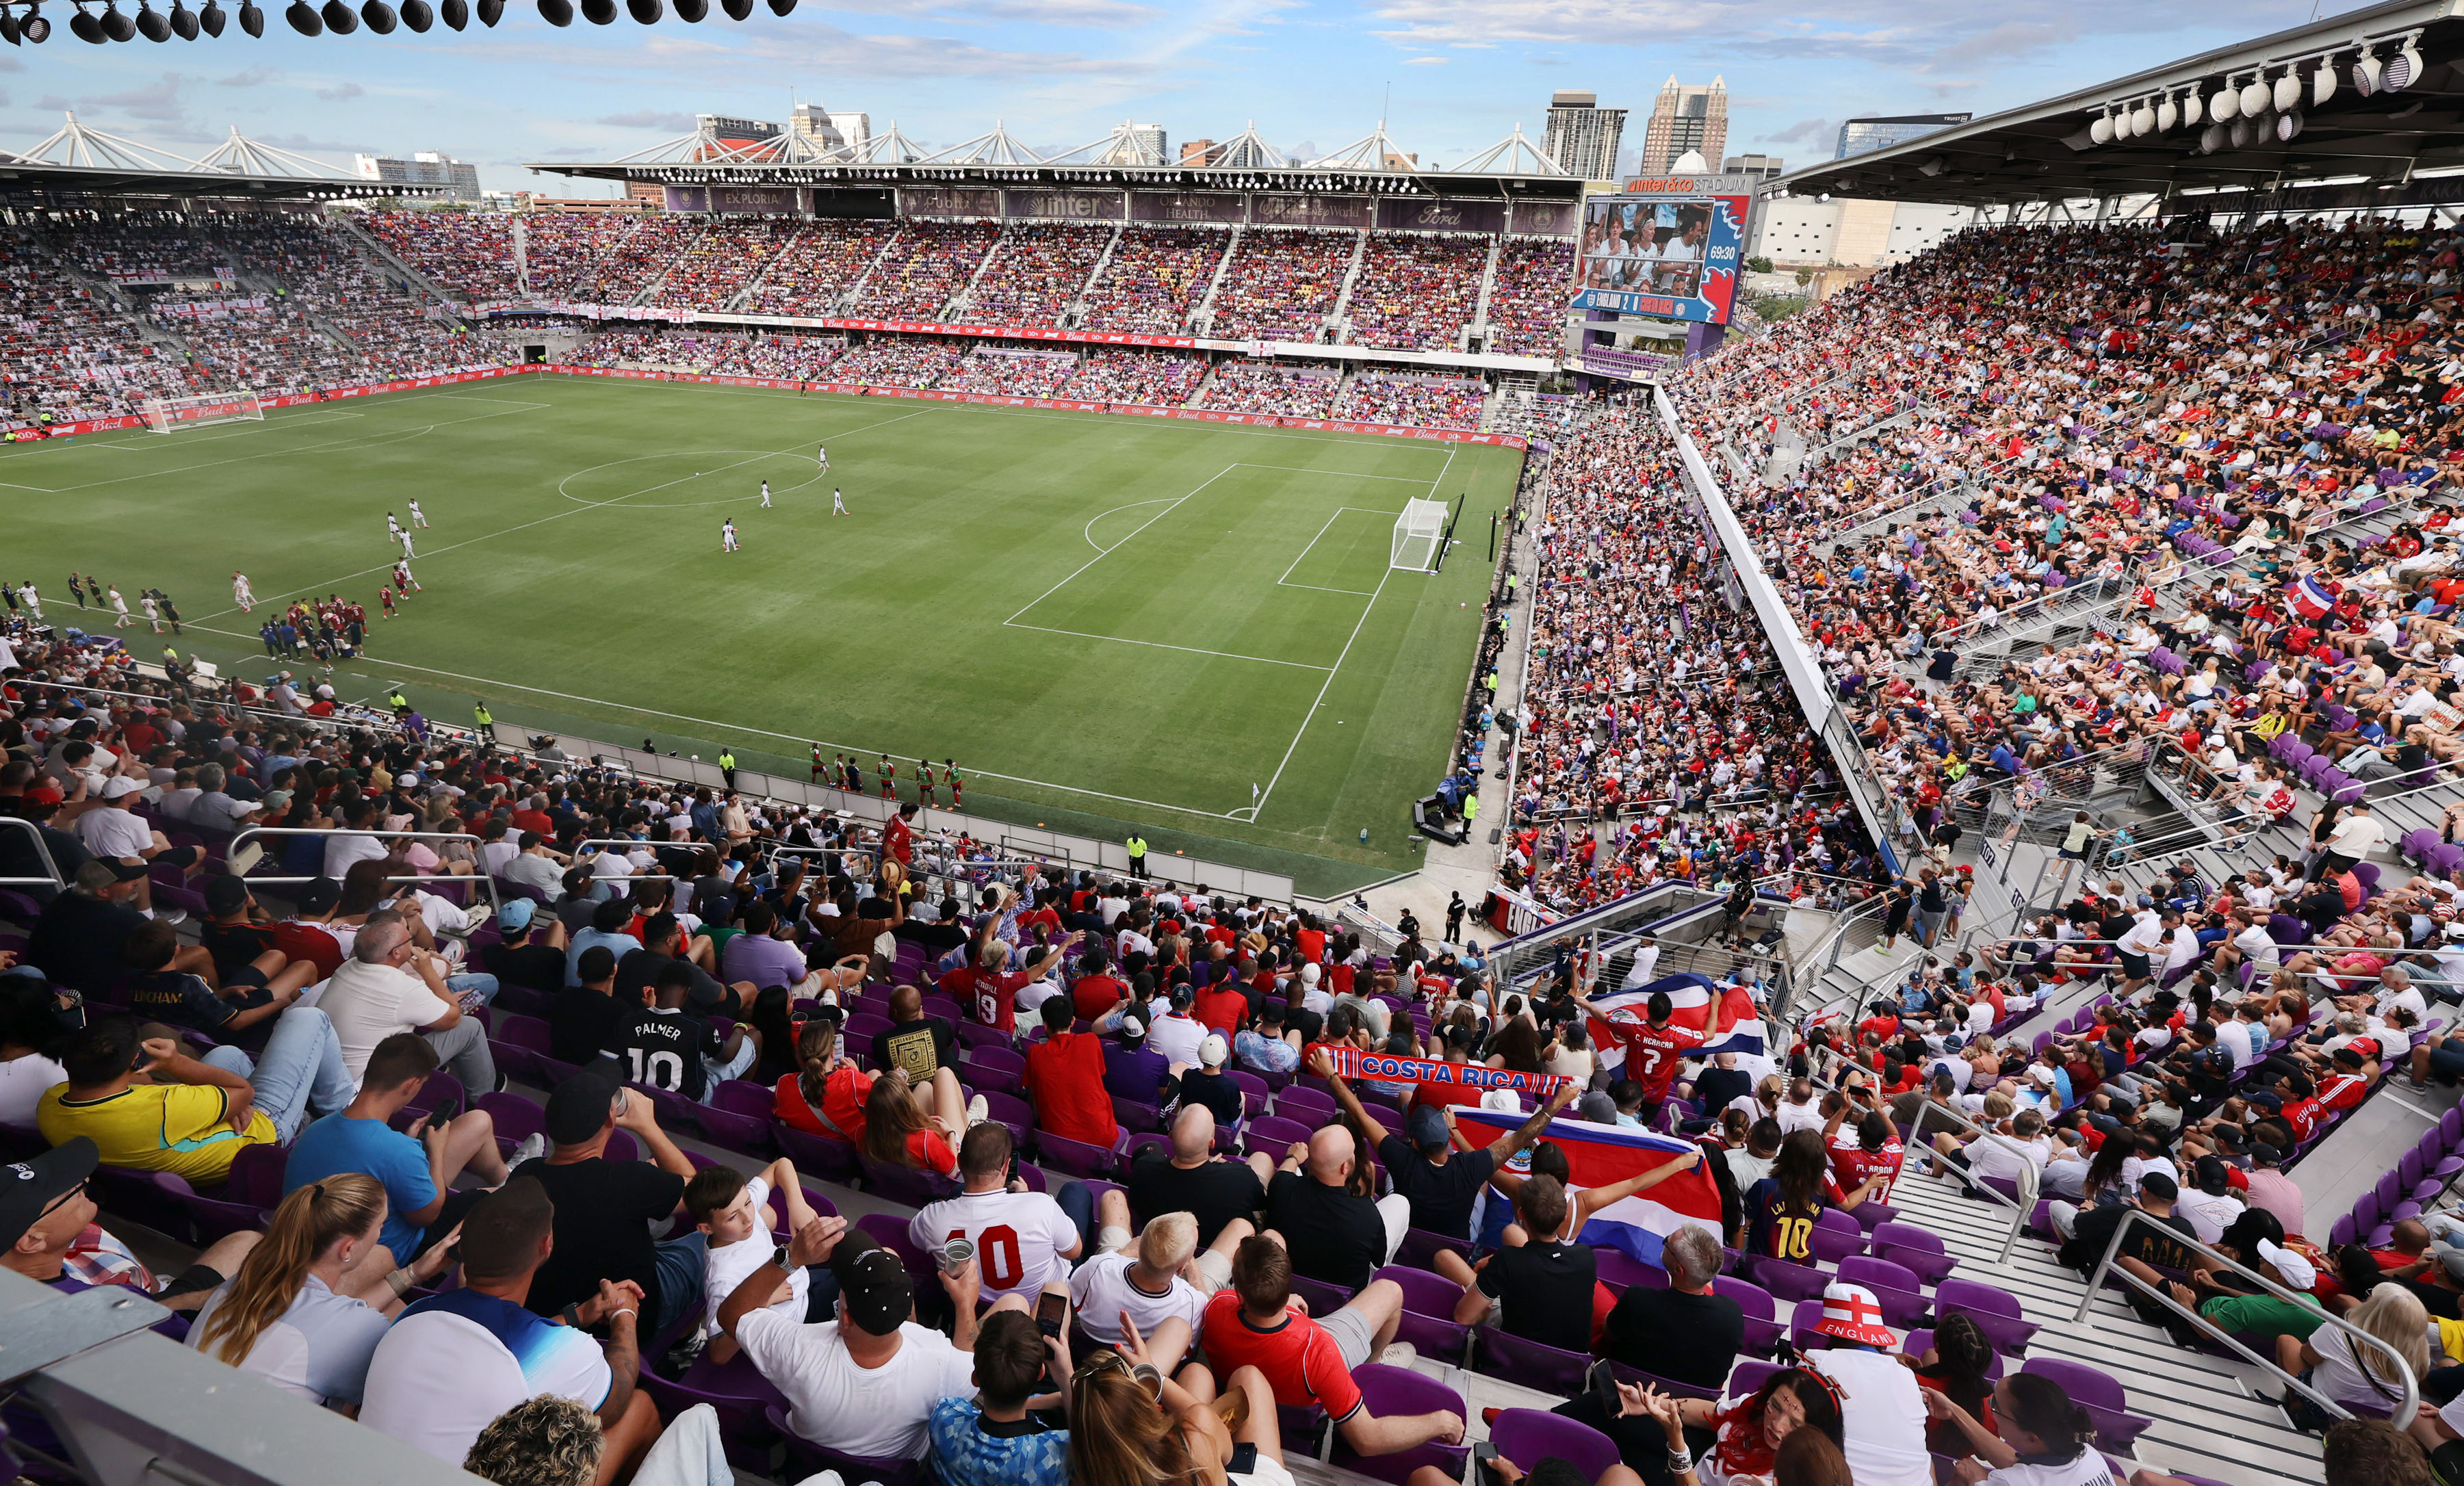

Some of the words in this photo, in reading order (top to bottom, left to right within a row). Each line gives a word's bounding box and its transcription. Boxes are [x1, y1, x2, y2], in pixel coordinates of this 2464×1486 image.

[1694, 179, 1748, 192] STADIUM
[725, 194, 779, 205] EXPLORIA
[1160, 196, 1215, 207] ORLANDO
[1330, 205, 1359, 218] World
[1418, 205, 1462, 225] Ford
[1711, 246, 1736, 260] 69:30
[1596, 292, 1621, 309] ENGLAND
[1623, 297, 1629, 310] 2
[1633, 296, 1639, 311] 0
[825, 320, 844, 328] Bud
[882, 322, 901, 330] Bud
[940, 325, 961, 334] Bud
[1001, 328, 1022, 337] Bud
[1064, 331, 1087, 341] Bud
[1129, 335, 1152, 344] Bud
[366, 384, 389, 394] Bud
[437, 376, 458, 385] Bud
[501, 367, 519, 376] Bud
[285, 395, 313, 405] Bud
[558, 365, 573, 374] Bud
[608, 369, 625, 378] Bud
[718, 376, 739, 386] Bud
[775, 380, 794, 389] Bud
[835, 385, 855, 394] Bud
[898, 390, 918, 399] Bud
[963, 394, 985, 404] Bud
[1032, 399, 1054, 408] Bud
[1176, 410, 1199, 419] Bud
[1252, 415, 1275, 426] Bud
[1331, 422, 1356, 432] Bud
[1413, 428, 1439, 439] Bud
[1500, 435, 1523, 448] Bud
[87, 417, 125, 432] Bud
[2430, 711, 2455, 728] COMING
[1982, 843, 1995, 865] 107
[1561, 955, 1569, 964] 7
[974, 988, 997, 1024] 19
[635, 1023, 682, 1041] PALMER
[894, 1035, 914, 1044] ORLANDO
[1635, 1034, 1642, 1043] C.
[1643, 1037, 1674, 1049] HERRERA
[627, 1047, 683, 1093] 10
[1644, 1049, 1661, 1074] 7
[1362, 1057, 1453, 1084] COSTA
[1462, 1068, 1527, 1089] RICA
[1869, 1165, 1893, 1174] ARANA
[1776, 1216, 1813, 1258] 10
[1825, 1326, 1893, 1344] ENGLAND
